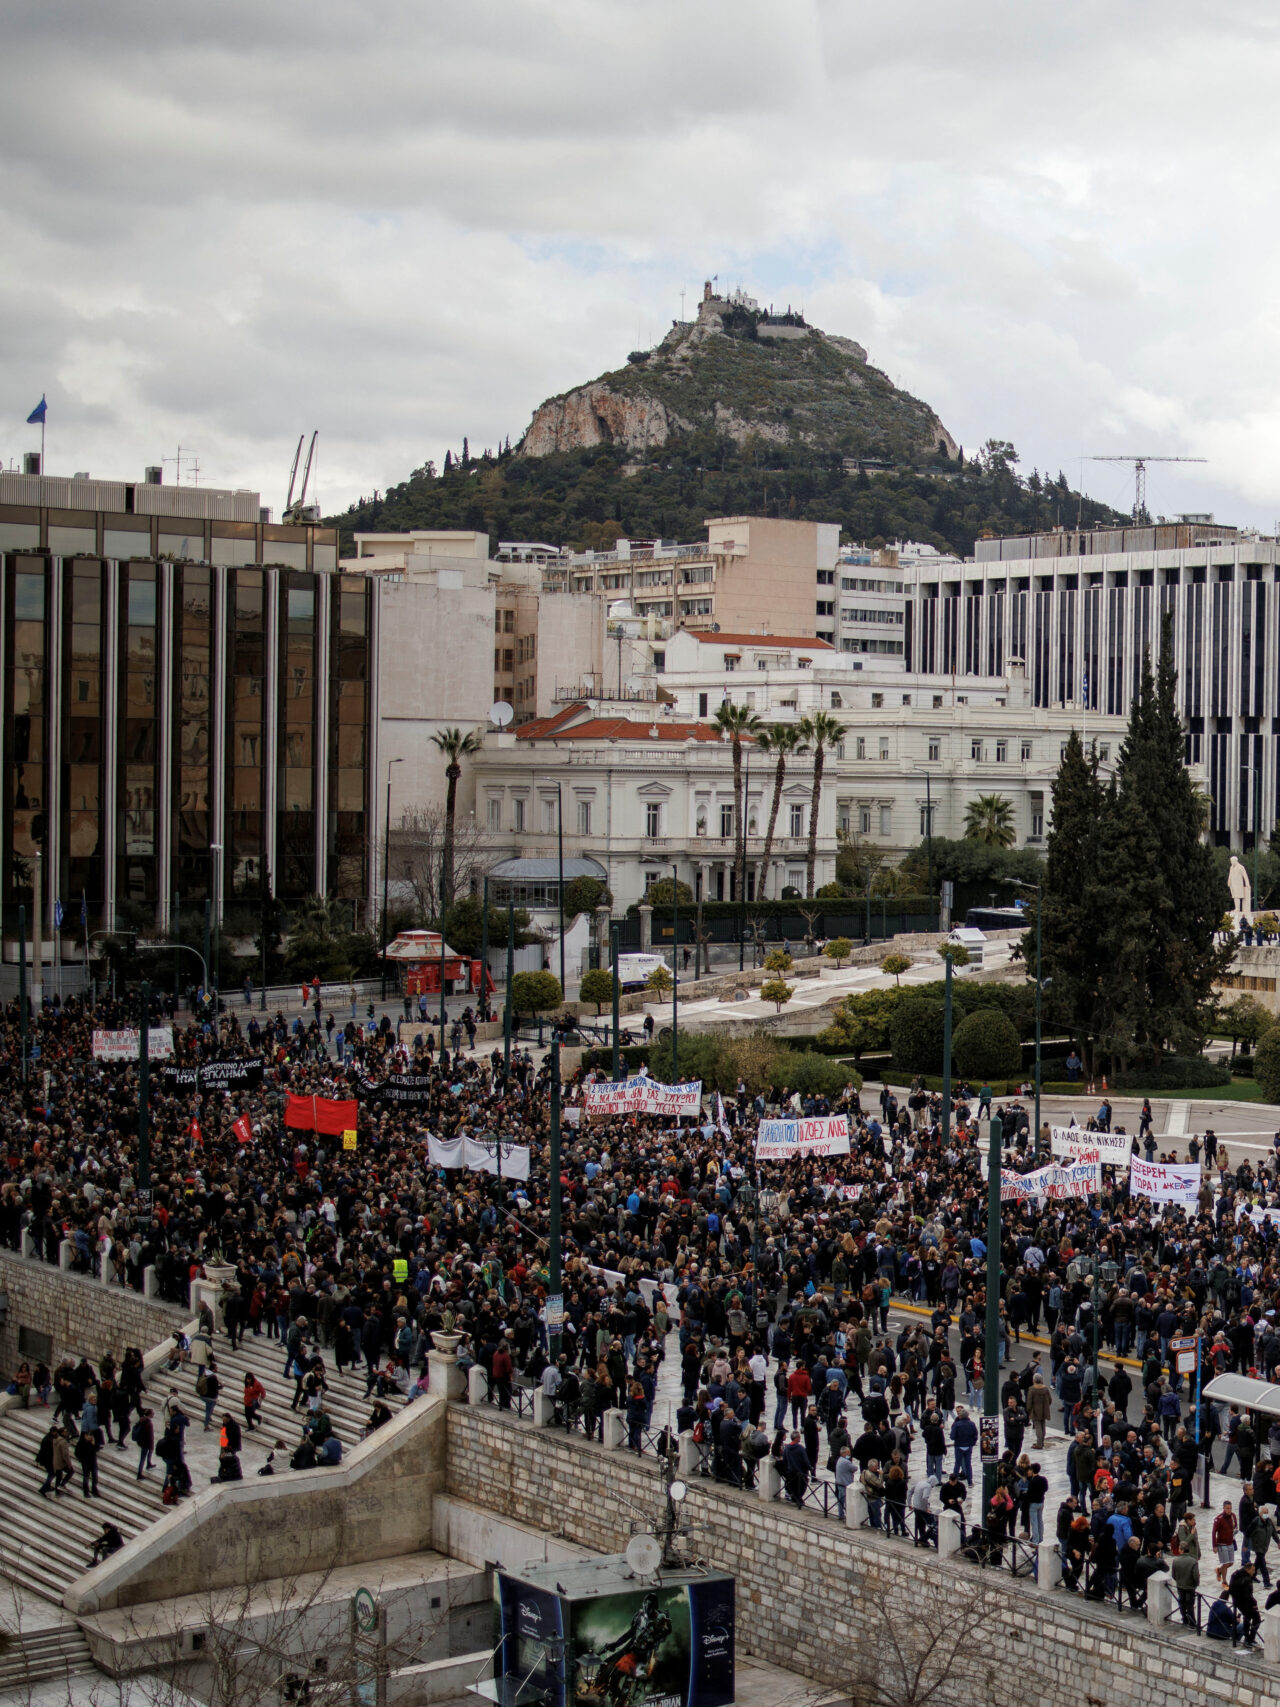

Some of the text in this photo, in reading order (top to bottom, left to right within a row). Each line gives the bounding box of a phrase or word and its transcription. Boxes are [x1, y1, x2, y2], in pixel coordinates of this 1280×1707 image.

[166, 1067, 179, 1075] ΔΕΝ
[200, 1063, 237, 1074] ΑΝΘΡΩΠΙΝΟ
[239, 1060, 262, 1069] ΛΑΘΟΣ
[630, 1087, 643, 1099] ΔΕΝ
[646, 1088, 660, 1100] ΣΑΣ
[654, 1102, 683, 1115] ΥΓΕΙΑΣ
[804, 1121, 825, 1141] ΖΩΕΣ
[828, 1119, 848, 1138] ΜΑΣ
[1053, 1129, 1126, 1148] Ο ΛΑΟΣ ΘΑ ΝΙΚΗΣΕΙ
[1040, 1174, 1049, 1188] ΔΕ
[702, 1632, 730, 1645] Disney+
